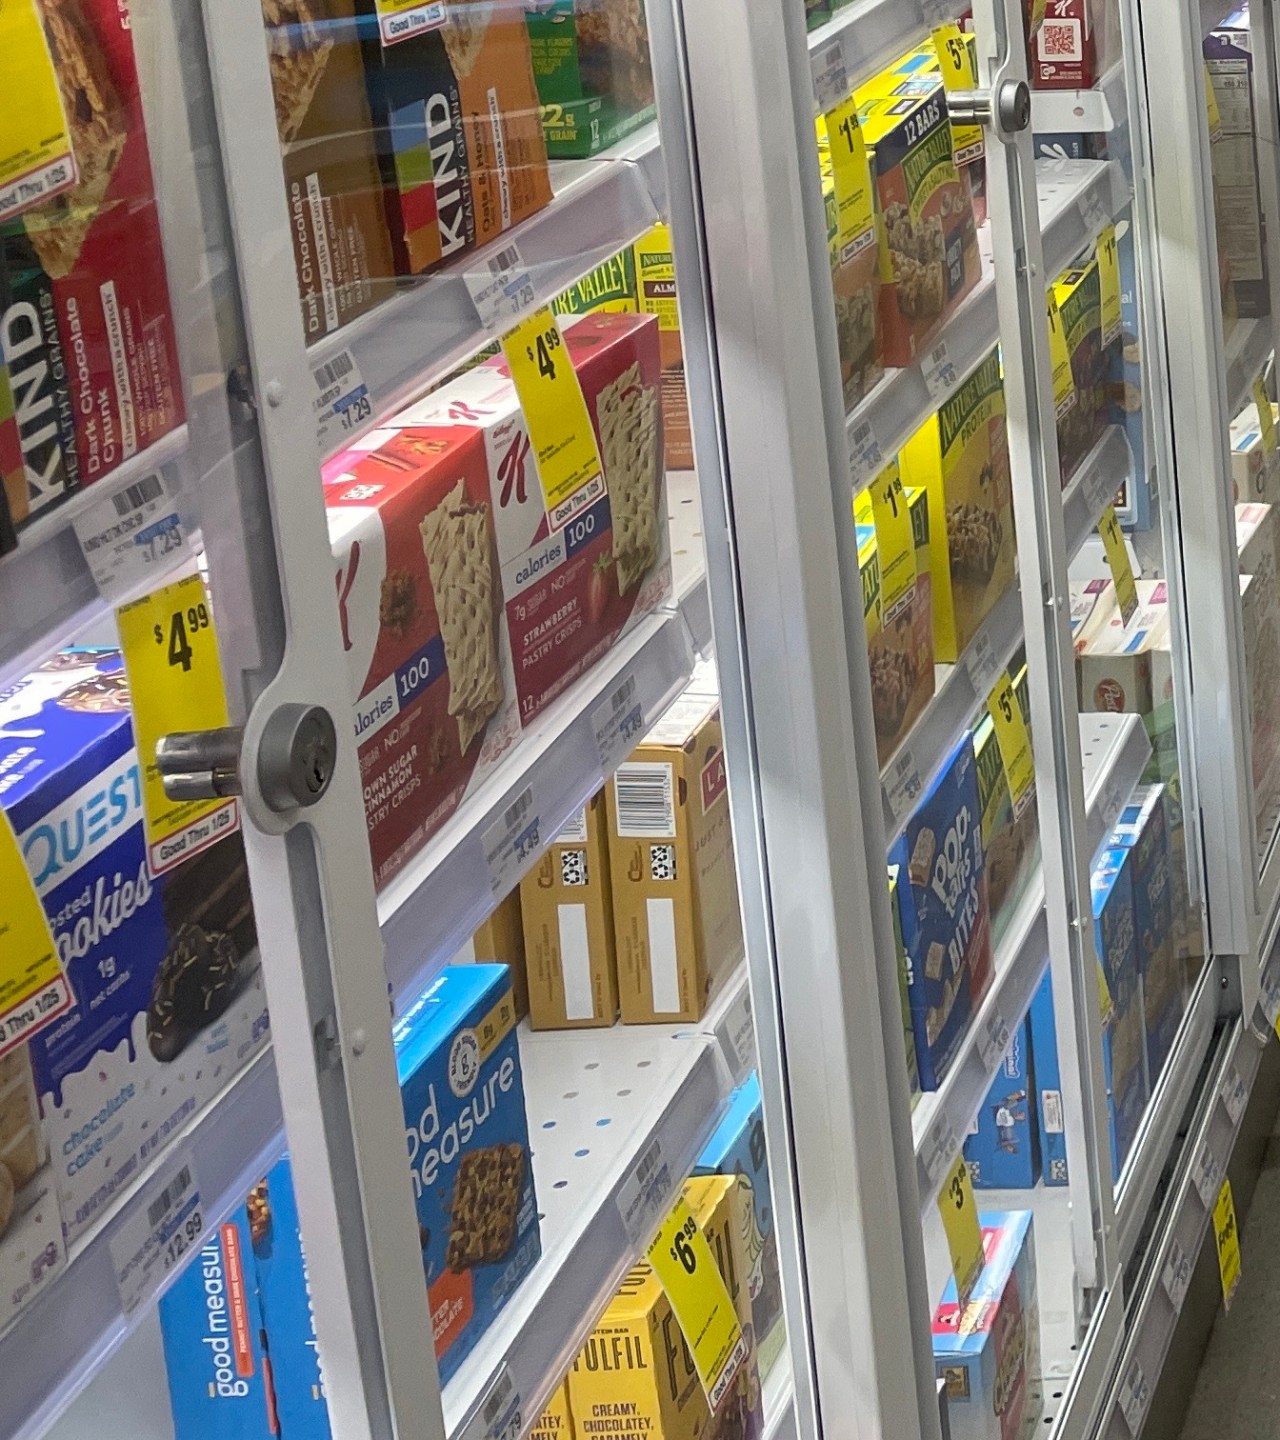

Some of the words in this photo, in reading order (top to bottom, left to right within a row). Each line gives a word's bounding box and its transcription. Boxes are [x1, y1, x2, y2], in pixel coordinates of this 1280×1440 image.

[389, 15, 407, 36] Good
[407, 11, 427, 30] Thru
[470, 110, 486, 169] Honey
[590, 118, 600, 150] 12
[904, 121, 918, 146] 12
[916, 100, 941, 136] BARS
[18, 175, 45, 200] Thru
[424, 91, 466, 258] KIND
[456, 165, 476, 244] HEALTHY
[479, 189, 491, 233] Oats
[290, 180, 315, 294] Chocolate
[510, 284, 536, 311] $7.29
[577, 249, 633, 305] VALLEY
[40, 288, 65, 382] GRAINS
[299, 294, 318, 334] Dark
[65, 296, 93, 416] Chocolate
[2, 298, 66, 514] KIND
[96, 388, 115, 465] Chunk
[341, 396, 372, 430] $7.29
[52, 386, 80, 488] HEALTHY
[75, 418, 101, 475] Dark
[553, 503, 572, 524] Good
[570, 490, 588, 512] Thru
[585, 479, 601, 497] 1/25
[514, 542, 562, 585] calories
[567, 514, 597, 548] 100
[550, 573, 566, 593] NO
[522, 597, 579, 647] STRAWBERRY
[522, 640, 553, 670] PASTRY
[554, 617, 583, 648] CRISPS
[399, 656, 430, 699] 100
[522, 694, 535, 712] 12
[388, 745, 418, 778] SUGAR
[391, 775, 422, 809] CRISPS
[24, 763, 143, 887] QUEST
[159, 835, 187, 861] Good
[187, 823, 210, 845] Thru
[210, 811, 231, 830] 1/25
[947, 879, 981, 974] BITES
[5, 1001, 34, 1035] Thru
[34, 987, 61, 1014] 1/25
[61, 1081, 136, 1157] chocolate
[66, 1137, 104, 1178] cake
[228, 1246, 240, 1282] CHOCOLATE
[613, 1327, 629, 1335] BAR
[203, 1332, 249, 1399] good
[712, 1375, 728, 1400] Good
[582, 1418, 655, 1434] CHOCOLATEY,
[591, 1402, 641, 1419] CREAMY,
